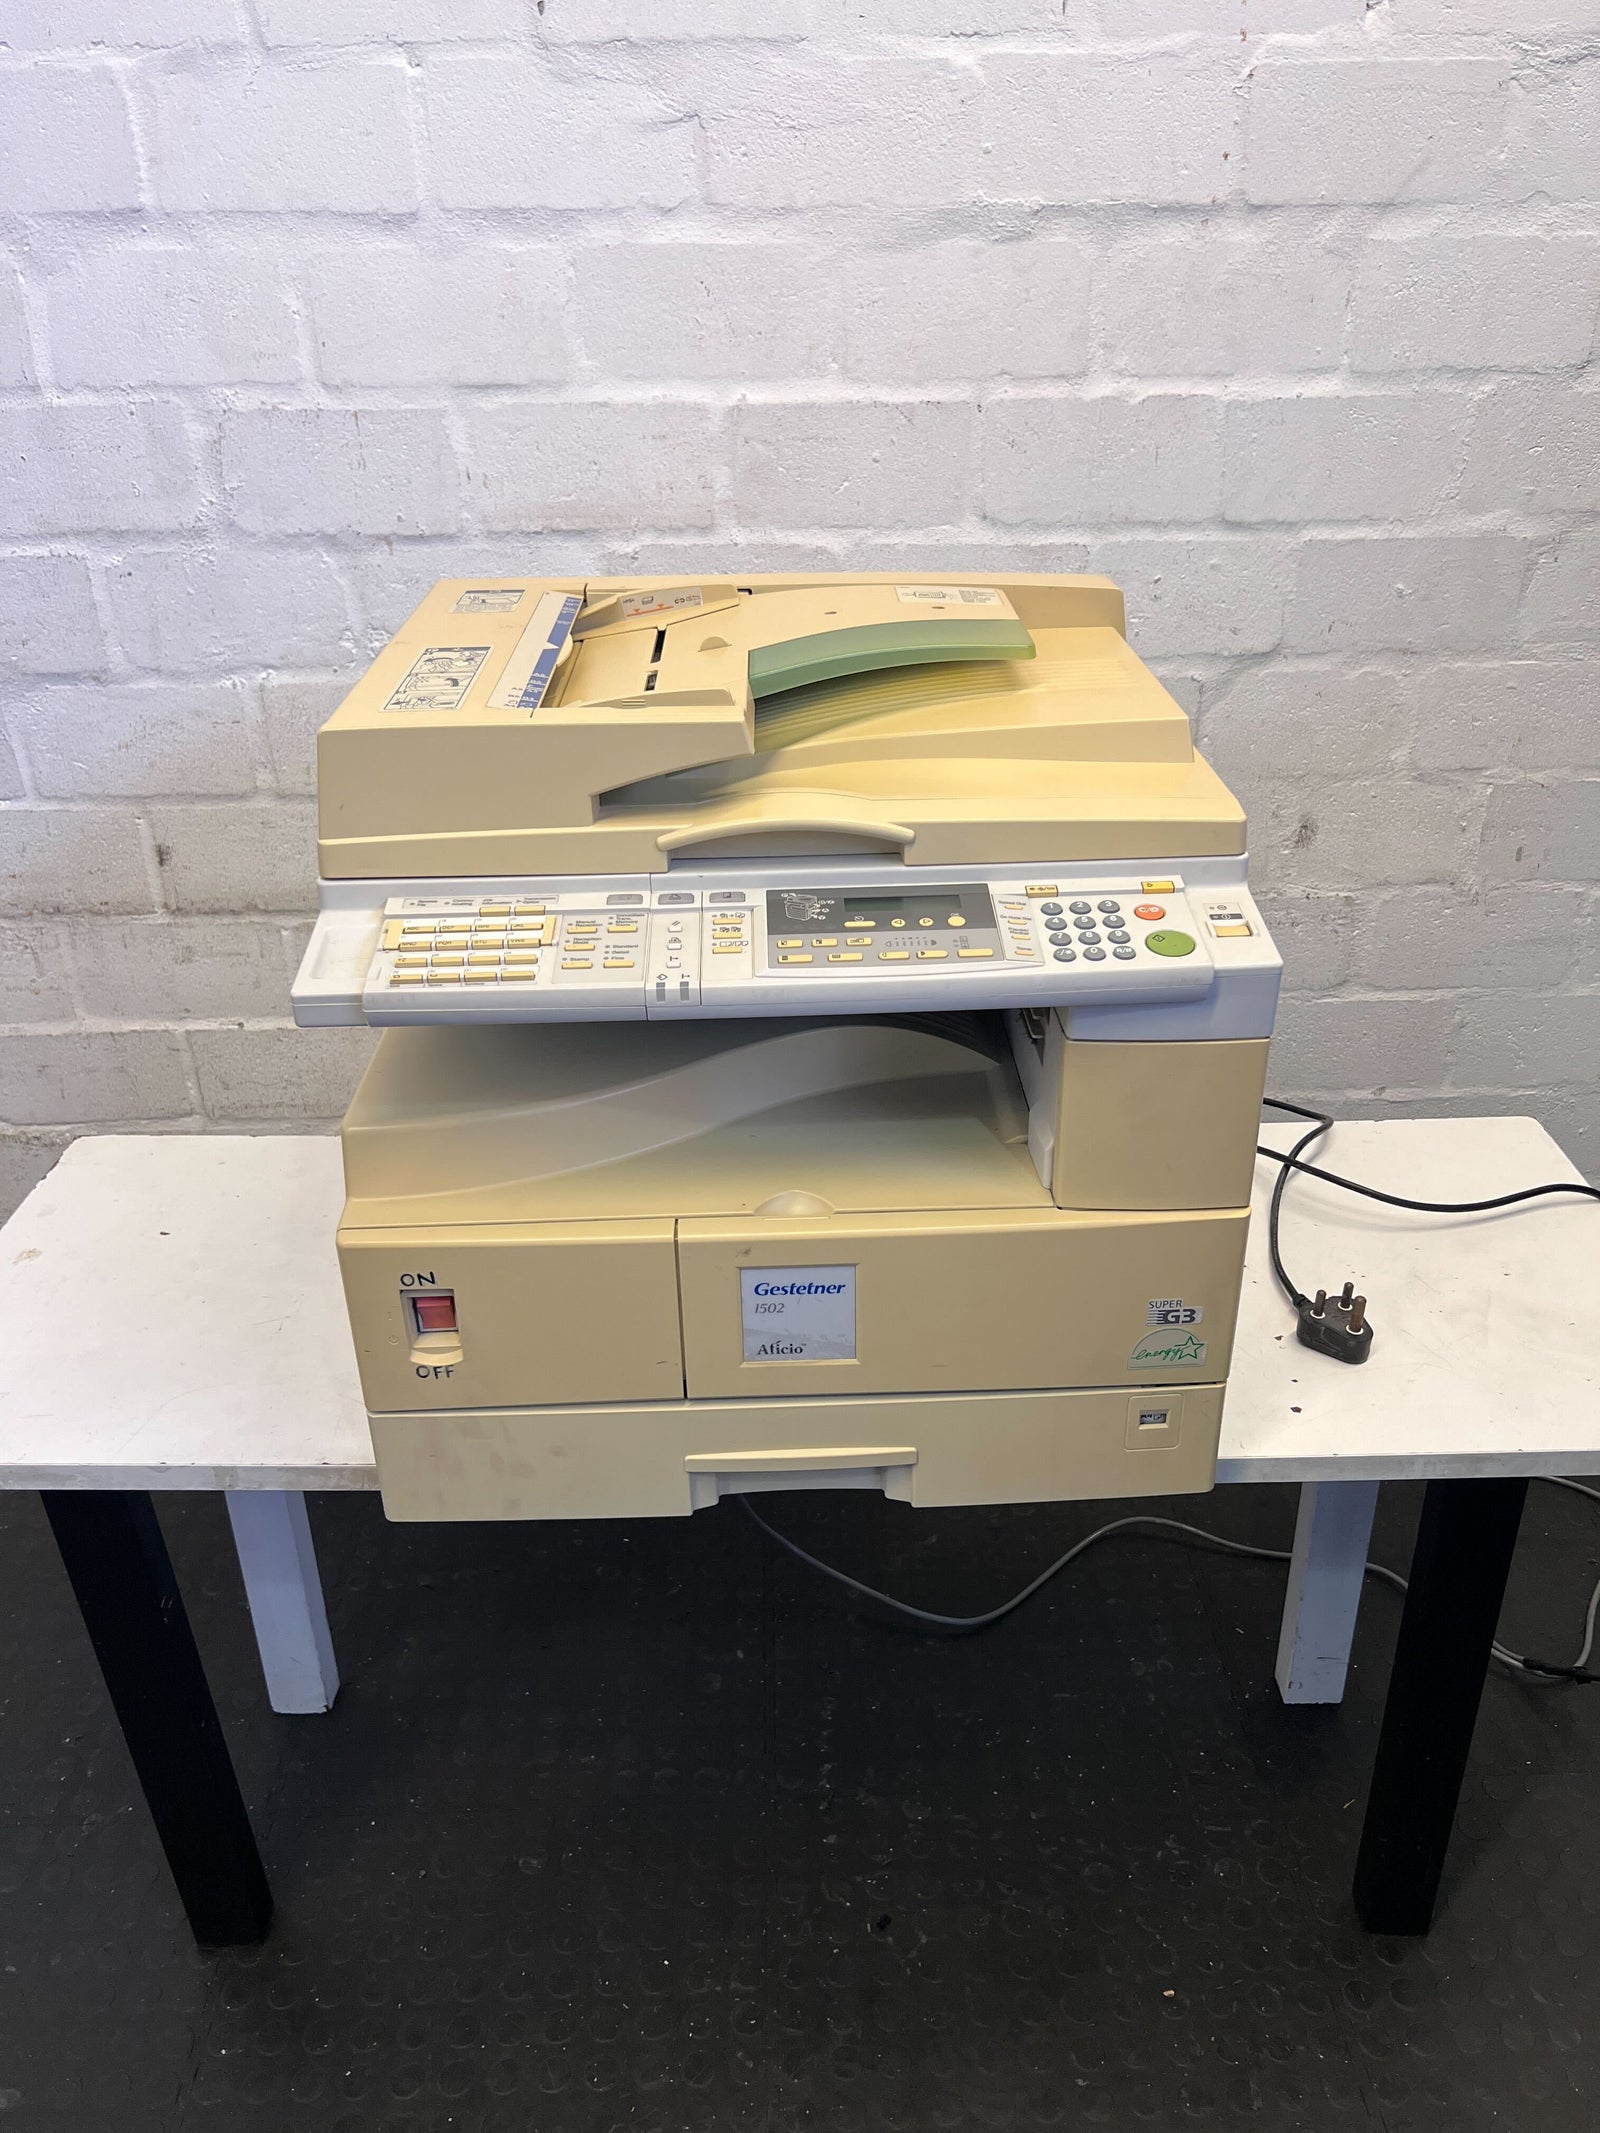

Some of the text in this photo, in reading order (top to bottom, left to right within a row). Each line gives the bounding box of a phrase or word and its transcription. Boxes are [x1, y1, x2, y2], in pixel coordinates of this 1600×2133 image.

[400, 1271, 437, 1287] ON
[754, 1281, 846, 1296] Gestetner
[754, 1302, 785, 1314] 1502
[1148, 1299, 1183, 1309] SUPER
[1156, 1308, 1196, 1325] G3
[415, 1364, 455, 1379] OFF
